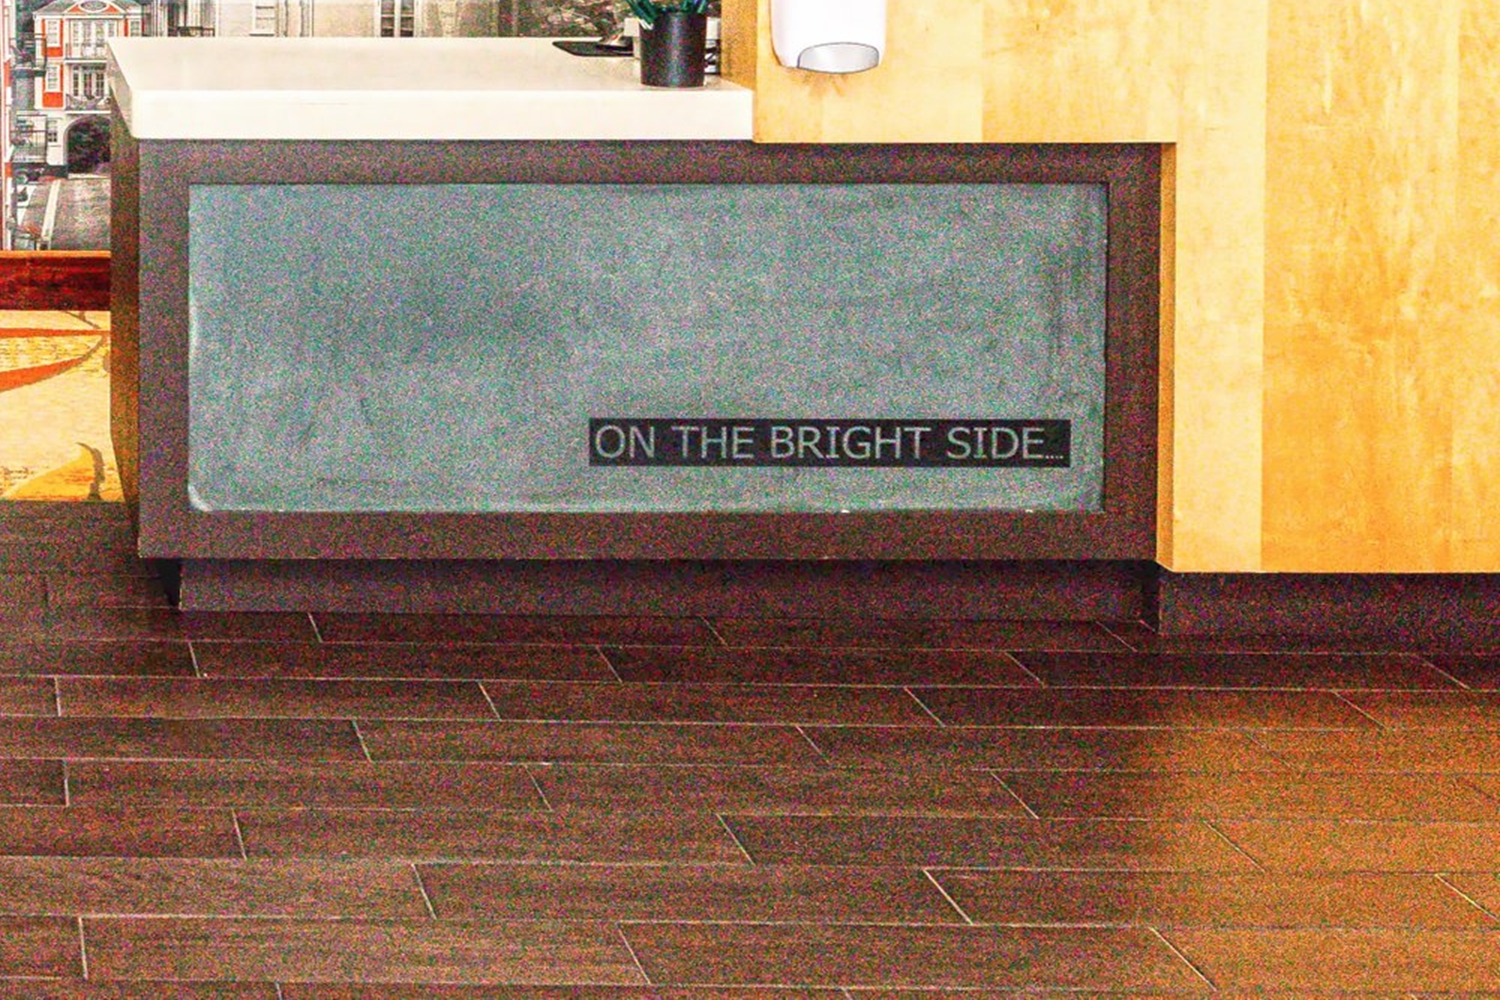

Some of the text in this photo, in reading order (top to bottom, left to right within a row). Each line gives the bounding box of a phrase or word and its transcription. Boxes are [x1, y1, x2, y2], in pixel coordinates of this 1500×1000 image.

[595, 425, 655, 459] ON
[671, 425, 755, 459] THE
[771, 425, 932, 460] BRIGHT
